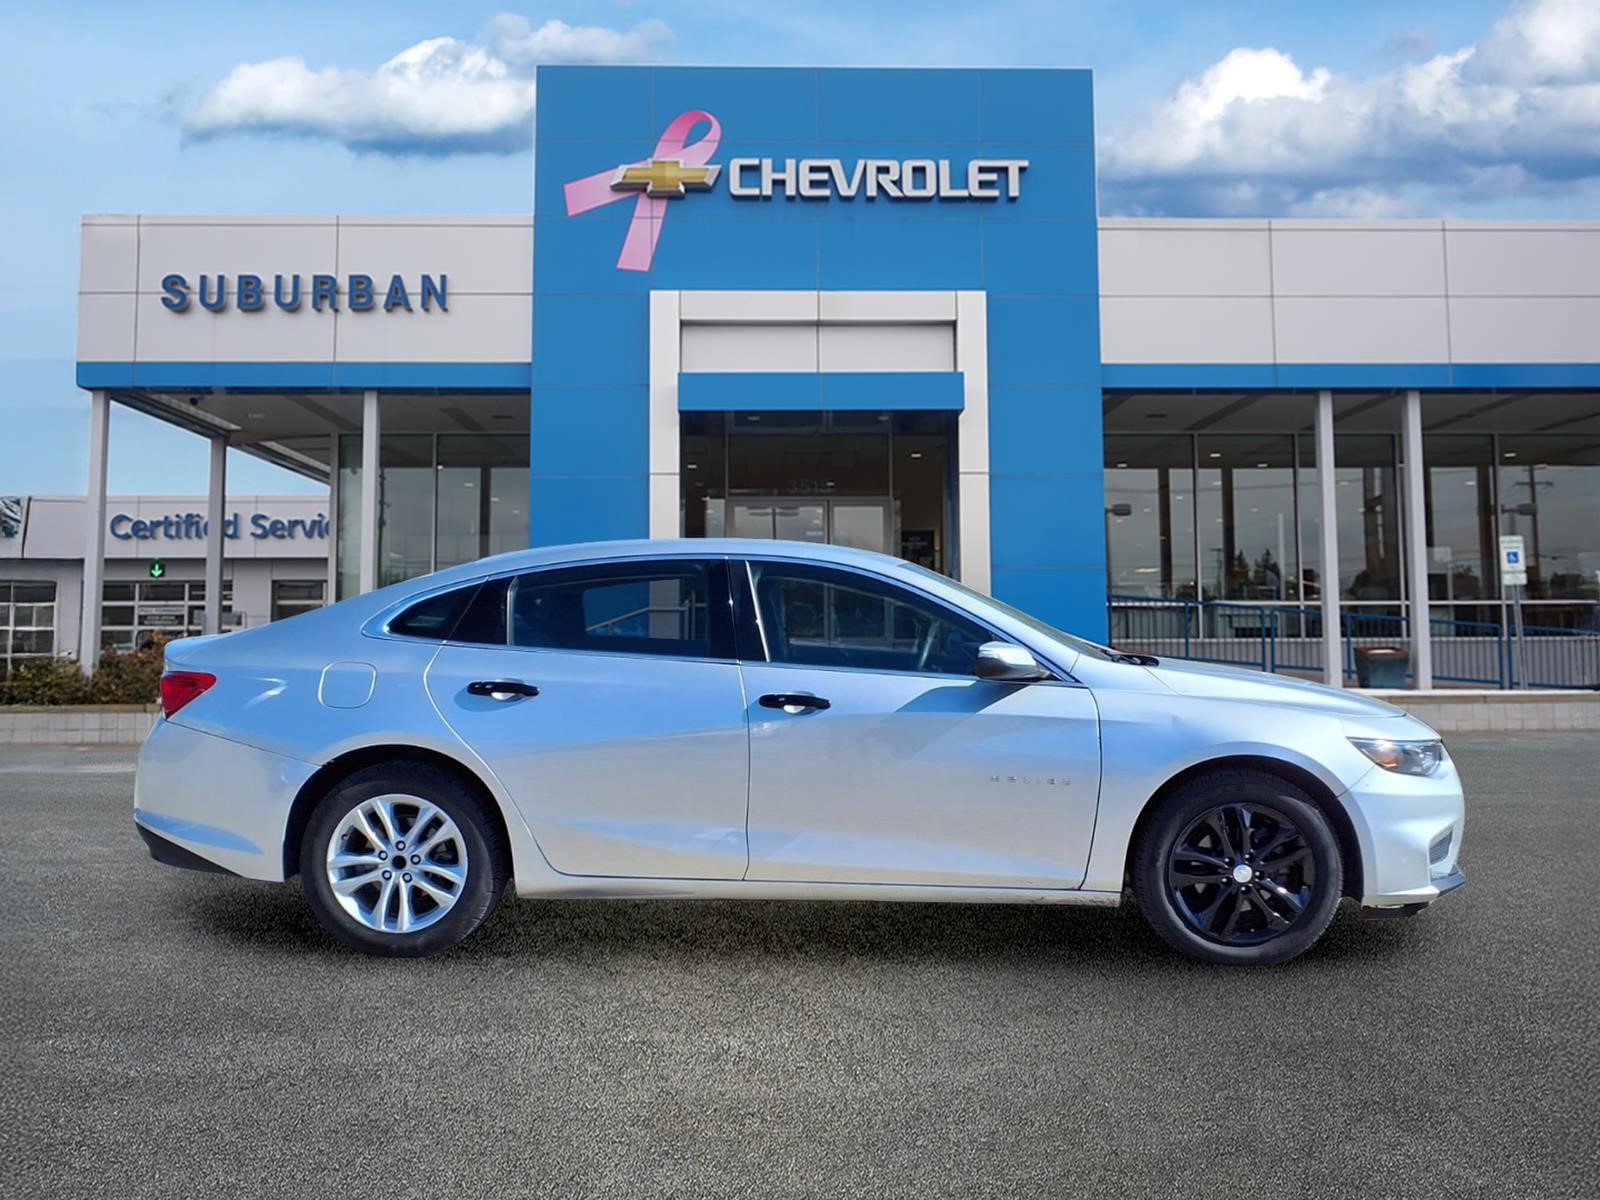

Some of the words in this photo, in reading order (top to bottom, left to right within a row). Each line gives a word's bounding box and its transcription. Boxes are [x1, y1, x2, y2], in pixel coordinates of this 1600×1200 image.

[729, 158, 1029, 198] CHEVROLET
[161, 274, 448, 312] SUBURBAN
[110, 513, 239, 540] Certifid
[250, 513, 330, 540] Servi
